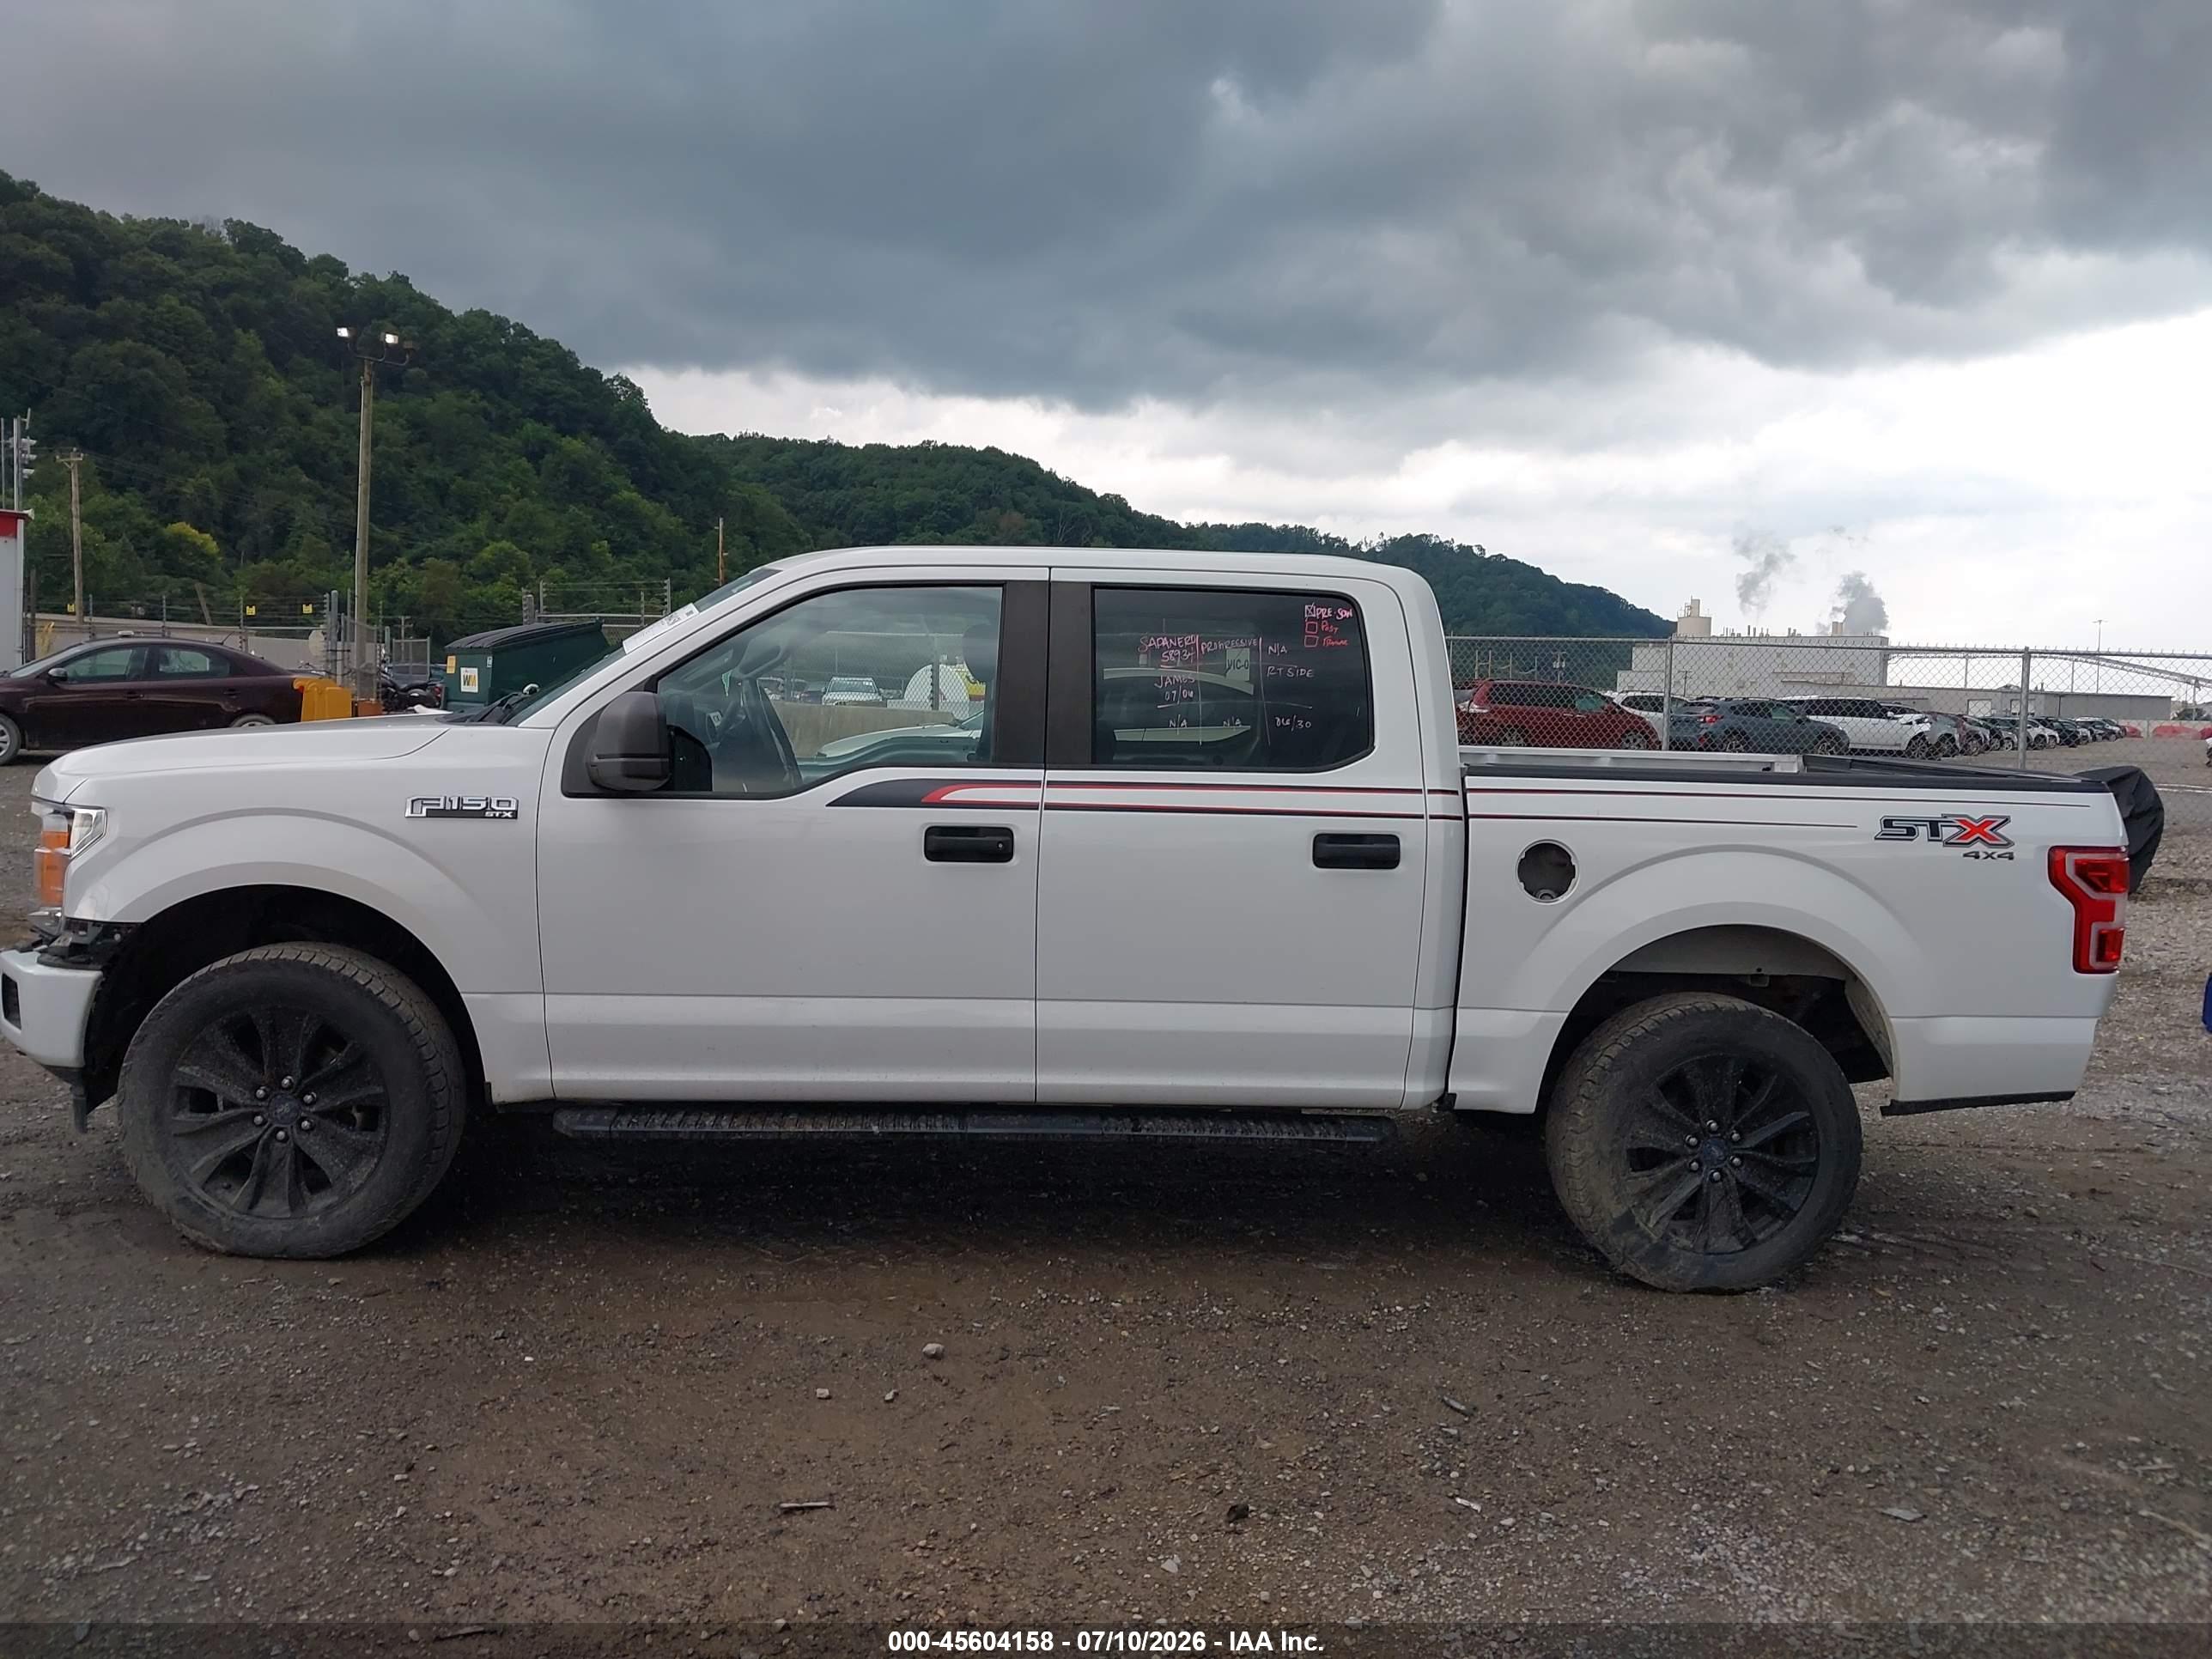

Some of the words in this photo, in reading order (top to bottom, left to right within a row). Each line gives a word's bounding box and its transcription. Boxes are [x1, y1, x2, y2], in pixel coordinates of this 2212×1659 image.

[1267, 642, 1287, 656] N/A
[463, 673, 477, 687] WM
[1169, 714, 1188, 735] N/A
[1875, 813, 2015, 848] STX
